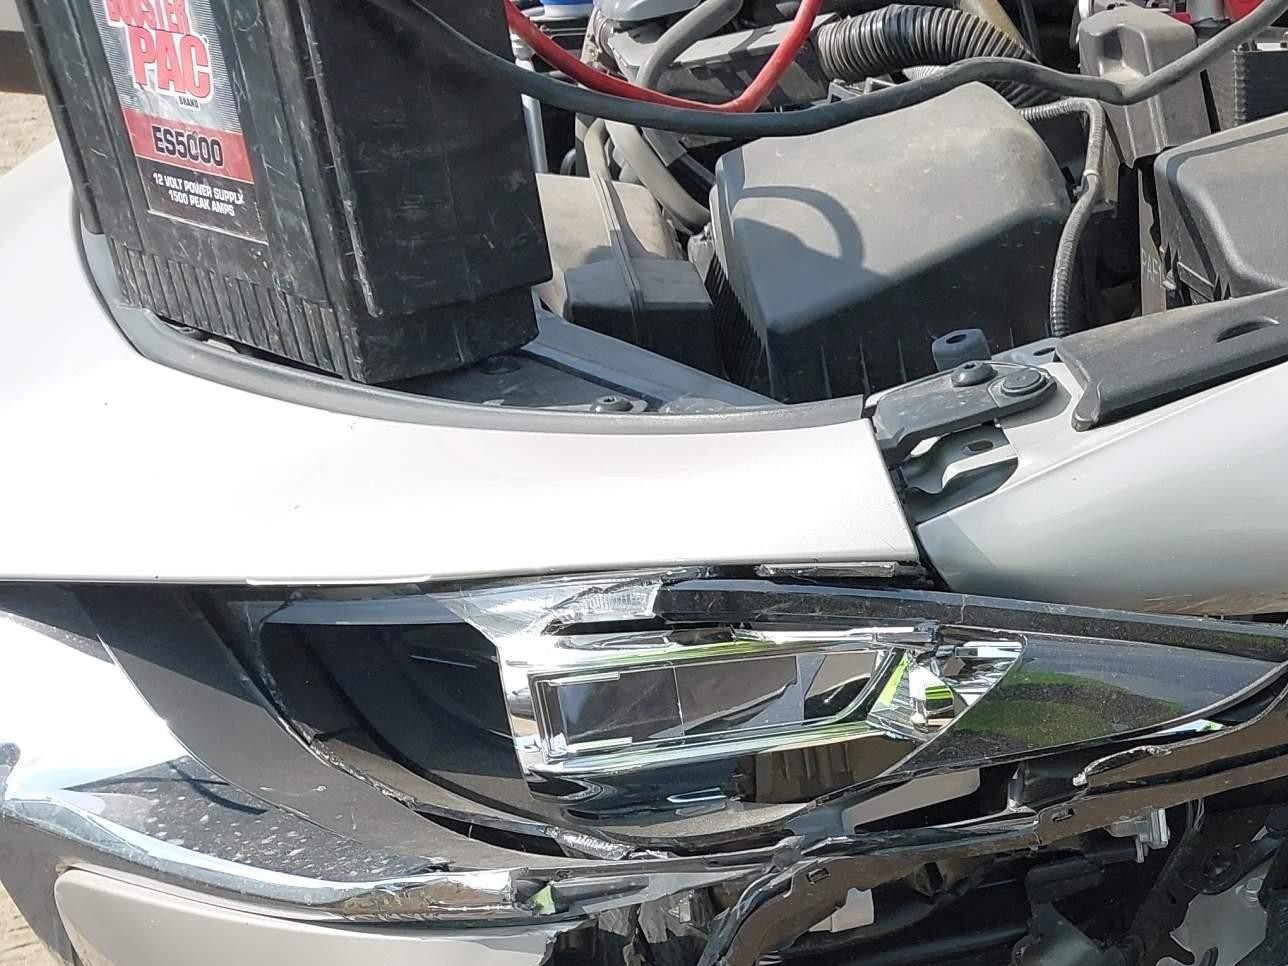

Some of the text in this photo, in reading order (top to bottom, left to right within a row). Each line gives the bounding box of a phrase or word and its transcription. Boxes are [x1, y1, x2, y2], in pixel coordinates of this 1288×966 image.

[128, 26, 212, 99] PAC
[152, 126, 224, 167] ES5000
[153, 173, 244, 205] 12 VOLT POWER SUPPLY
[169, 189, 235, 217] 1500 PEAK AMPS
